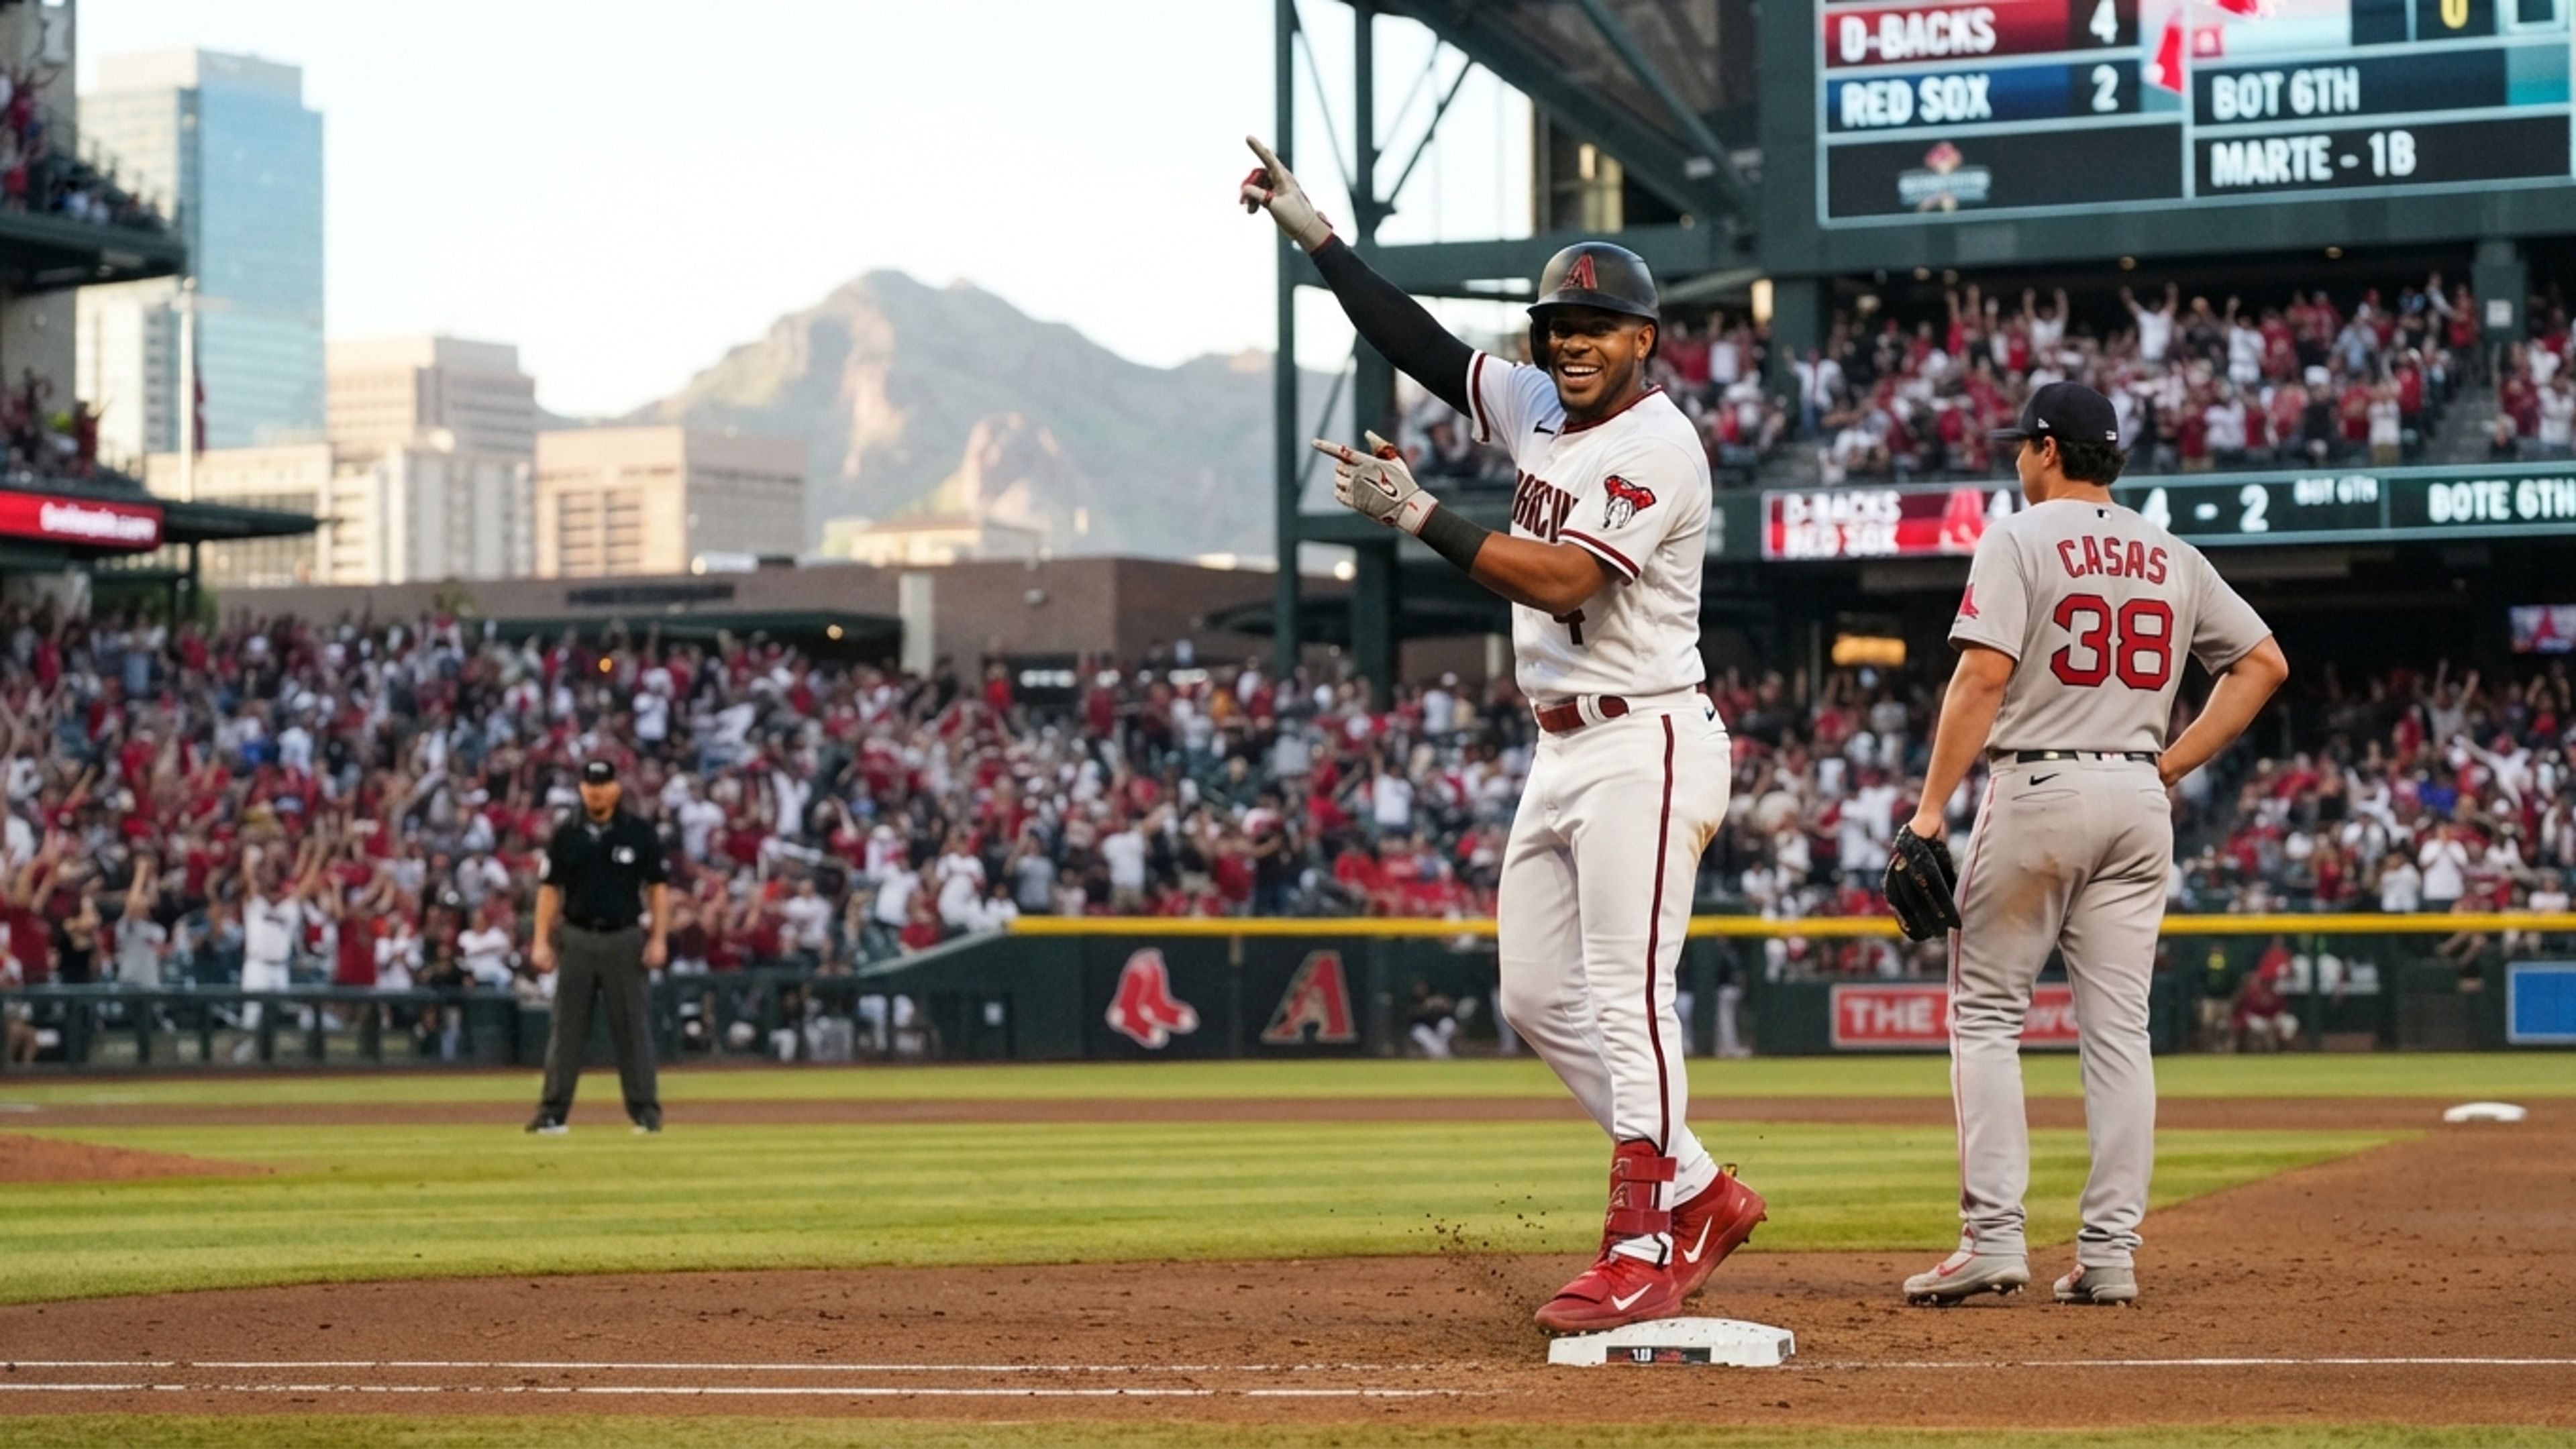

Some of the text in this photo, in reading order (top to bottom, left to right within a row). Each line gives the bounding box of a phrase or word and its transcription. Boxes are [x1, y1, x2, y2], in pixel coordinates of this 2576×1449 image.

[1840, 0, 2118, 62] D-BACKS 4
[1841, 64, 2119, 127] RED SOX 2
[2212, 66, 2360, 120] BOT 6TH
[2211, 130, 2416, 187] MARTE - 1B
[2240, 484, 2269, 532] 2
[2428, 478, 2576, 523] BOTE 6TH
[2057, 535, 2167, 585] CASAS
[2050, 593, 2173, 691] 38
[1845, 998, 1935, 1034] THE
